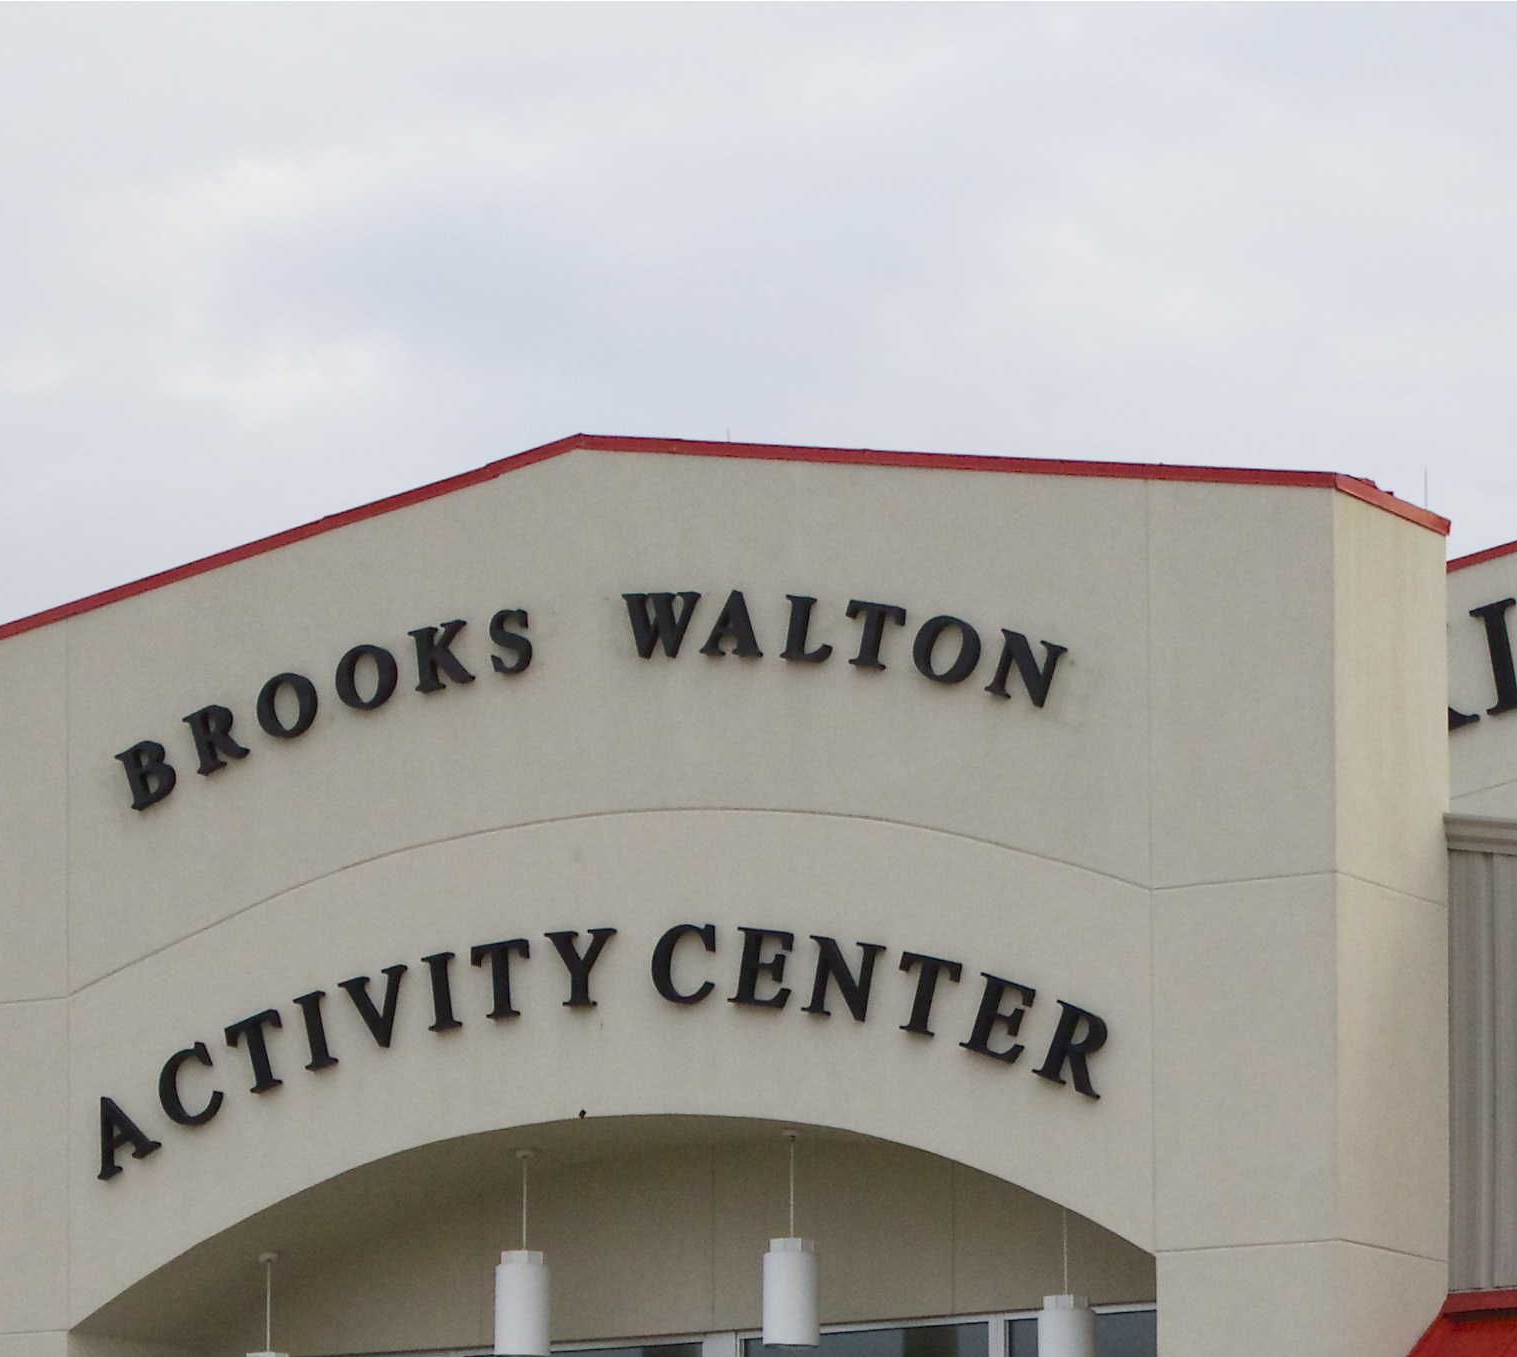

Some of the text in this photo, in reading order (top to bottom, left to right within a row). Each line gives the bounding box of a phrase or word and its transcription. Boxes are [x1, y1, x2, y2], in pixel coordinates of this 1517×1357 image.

[115, 589, 1069, 812] BROOKS WALTON
[96, 923, 1110, 1181] ACTIVITY CENTER
